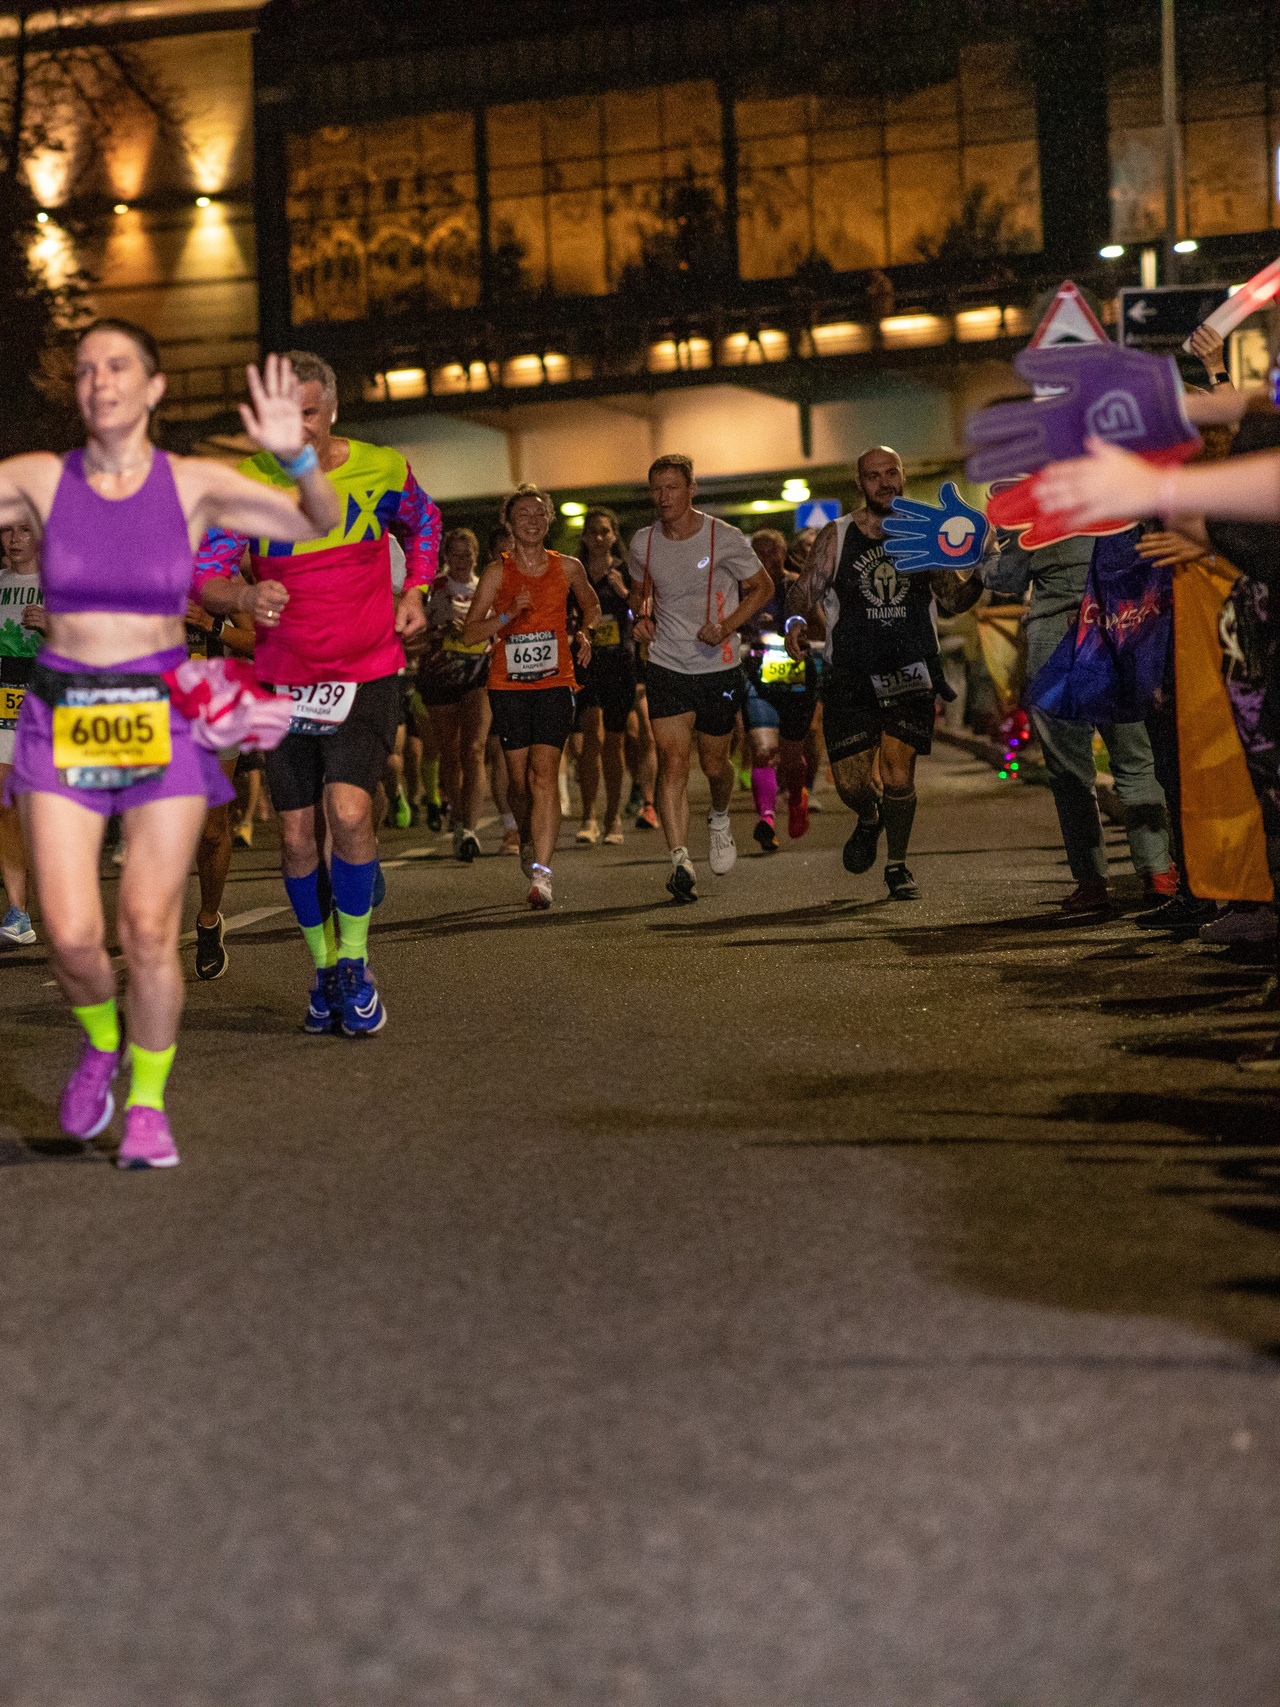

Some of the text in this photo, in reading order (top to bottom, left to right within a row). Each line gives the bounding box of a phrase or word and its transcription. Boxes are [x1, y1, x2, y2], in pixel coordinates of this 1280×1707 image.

[865, 606, 907, 619] TRAINING
[513, 645, 552, 664] 6632
[879, 667, 923, 688] 5154
[289, 683, 345, 707] 5739
[296, 704, 332, 716] ГЕННАДИЙ
[71, 714, 154, 745] 6005
